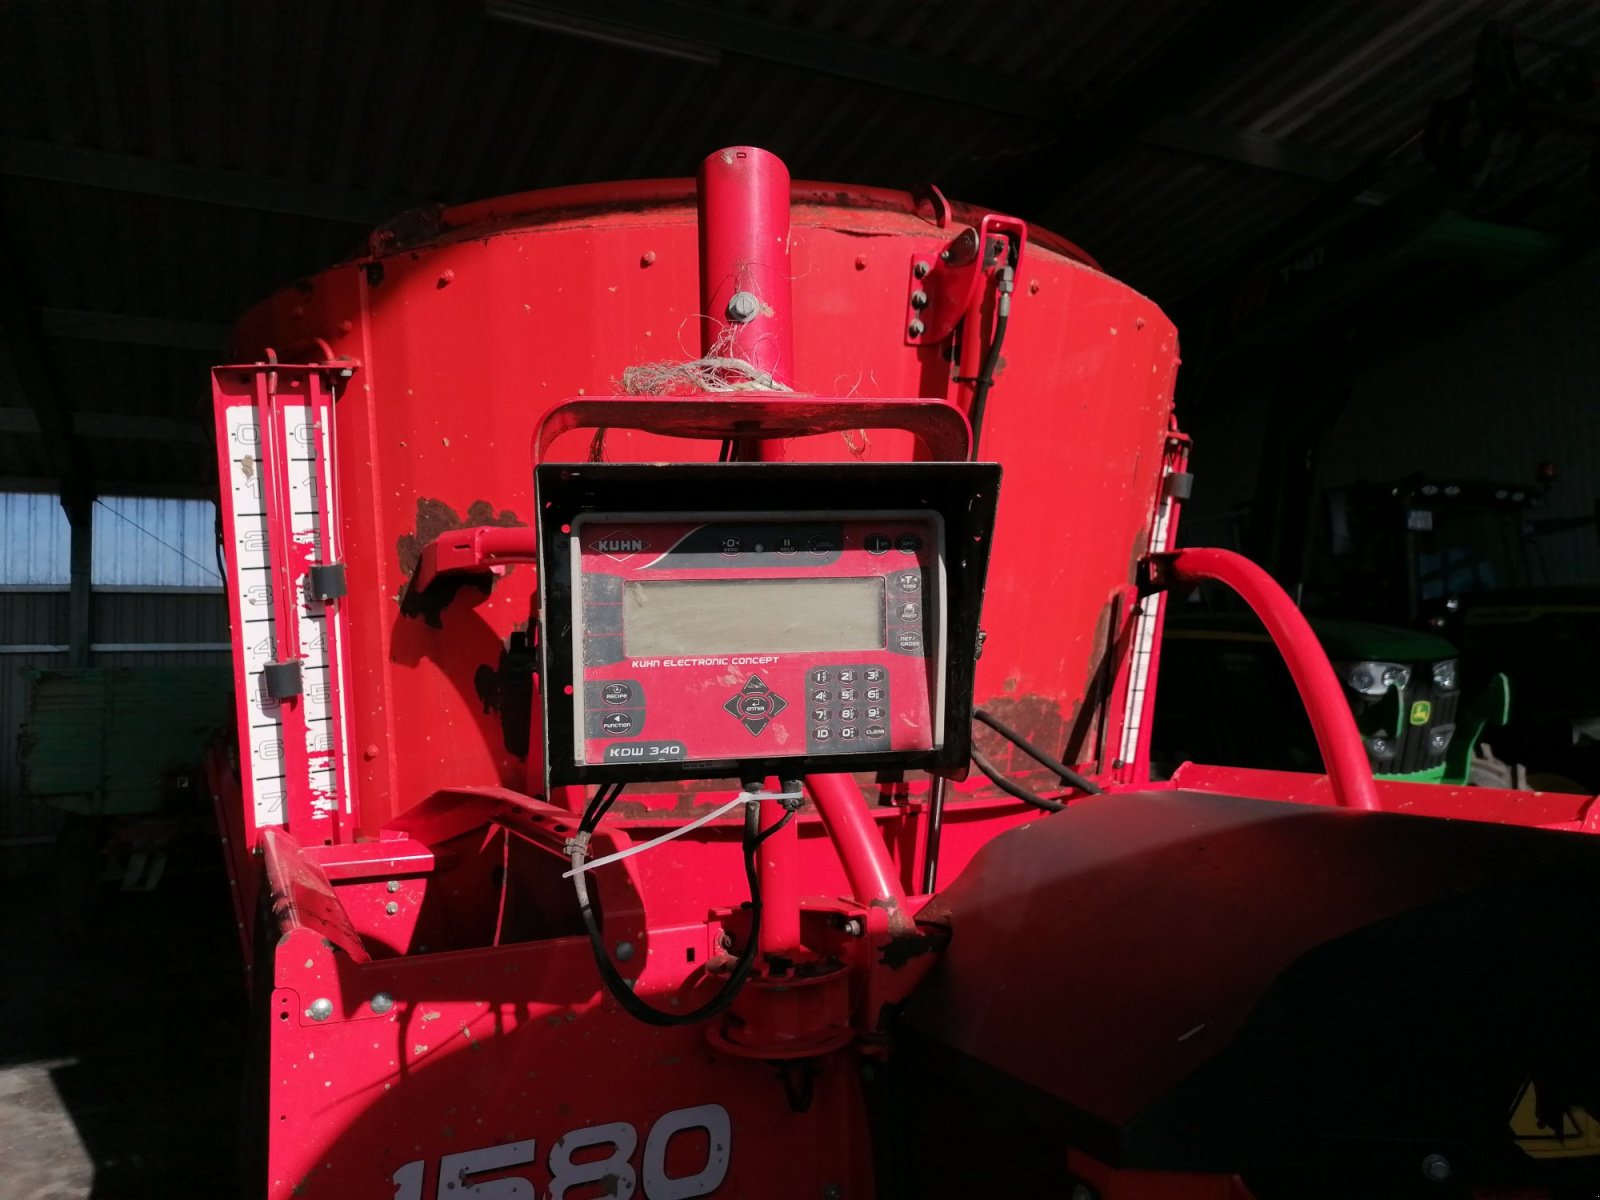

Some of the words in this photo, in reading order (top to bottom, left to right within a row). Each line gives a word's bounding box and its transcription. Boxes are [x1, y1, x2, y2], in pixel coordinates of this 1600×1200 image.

[237, 424, 261, 445] 0
[245, 477, 261, 499] 1
[302, 476, 317, 498] 1
[244, 530, 270, 552] 2
[598, 540, 642, 551] KUHN
[248, 585, 274, 606] 3
[254, 636, 277, 658] 4
[664, 658, 728, 667] ELECTRONIC
[732, 656, 779, 664] CONCEPT
[259, 739, 284, 760] 6
[610, 747, 644, 757] KDW
[649, 746, 680, 755] 340
[262, 790, 287, 813] 7
